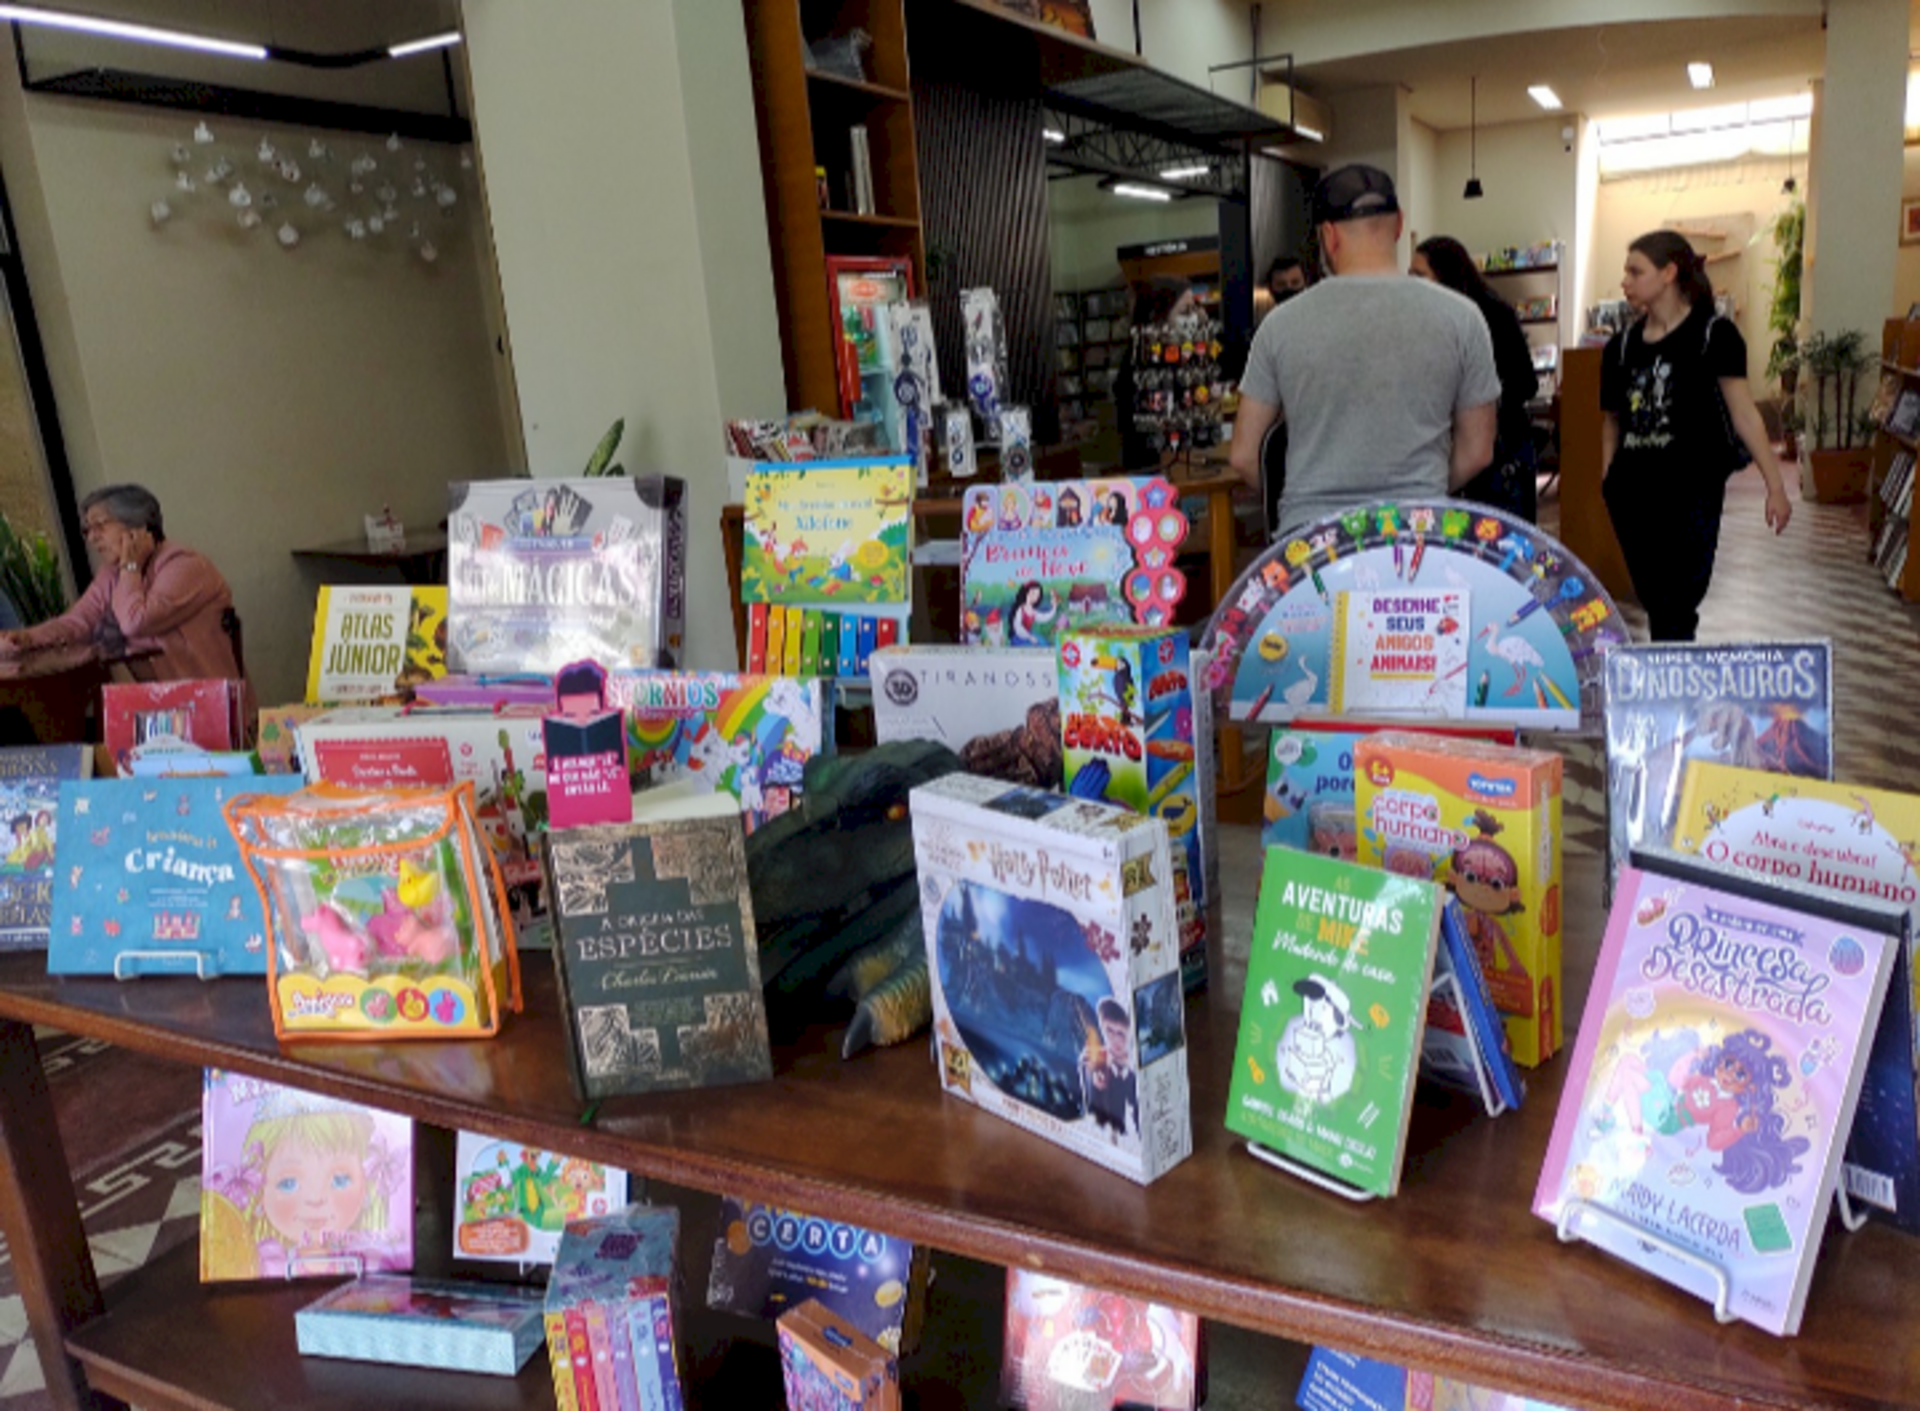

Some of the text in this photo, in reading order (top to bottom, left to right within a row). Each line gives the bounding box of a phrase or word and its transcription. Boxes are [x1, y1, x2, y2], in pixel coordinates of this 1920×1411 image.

[985, 543, 1070, 563] Branca
[1041, 559, 1089, 578] Neve
[1372, 597, 1440, 614] DESENHE
[1386, 616, 1425, 632] SEUS
[340, 612, 394, 640] ATLAS
[1375, 634, 1435, 651] AMIGOS
[325, 640, 401, 676] JÚNIOR
[1370, 654, 1437, 672] ANIMAIS!
[1616, 650, 1817, 700] DINOSSAUROS
[1375, 815, 1470, 851] humano
[1752, 830, 1788, 852] Abra
[1802, 840, 1878, 870] descubra!
[124, 846, 236, 888] Criança
[988, 841, 1092, 901] Harry Potter
[1706, 840, 1917, 905] O corpo humano
[1281, 881, 1404, 934] AVENTURAS
[576, 923, 732, 961] ESPÉCIES
[1317, 918, 1371, 955] MIKE
[1641, 944, 1832, 1026] Desastrada
[752, 1219, 879, 1256] CERTA
[1666, 1199, 1741, 1251] LACERDA
